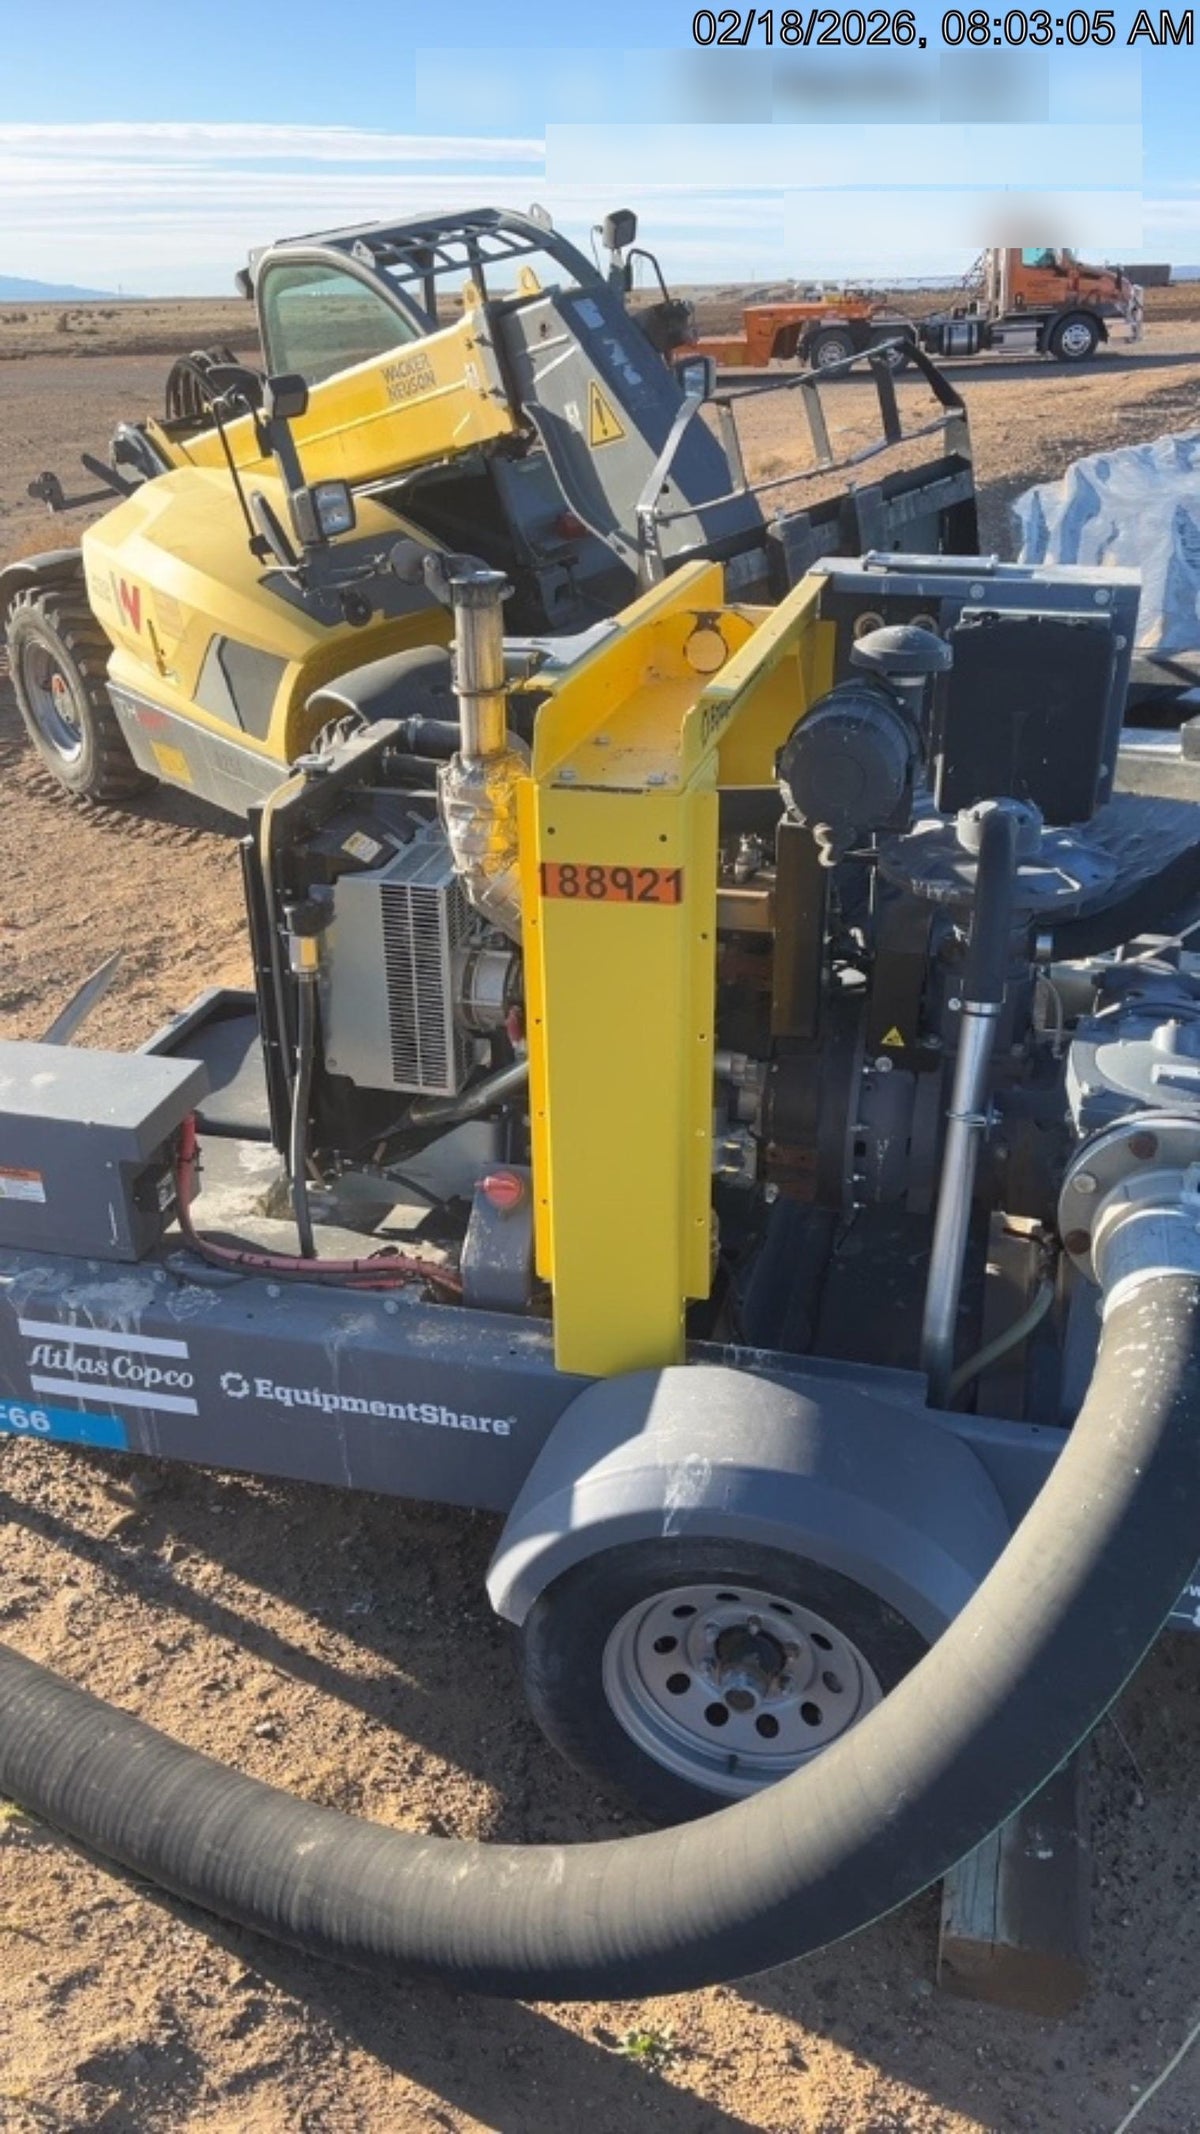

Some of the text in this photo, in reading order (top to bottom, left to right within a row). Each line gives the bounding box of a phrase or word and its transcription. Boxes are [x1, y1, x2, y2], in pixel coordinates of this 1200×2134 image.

[380, 352, 431, 383] WACKER
[386, 369, 437, 402] NEUSON
[539, 862, 683, 903] 188921
[26, 1343, 194, 1389] Atlas Copco
